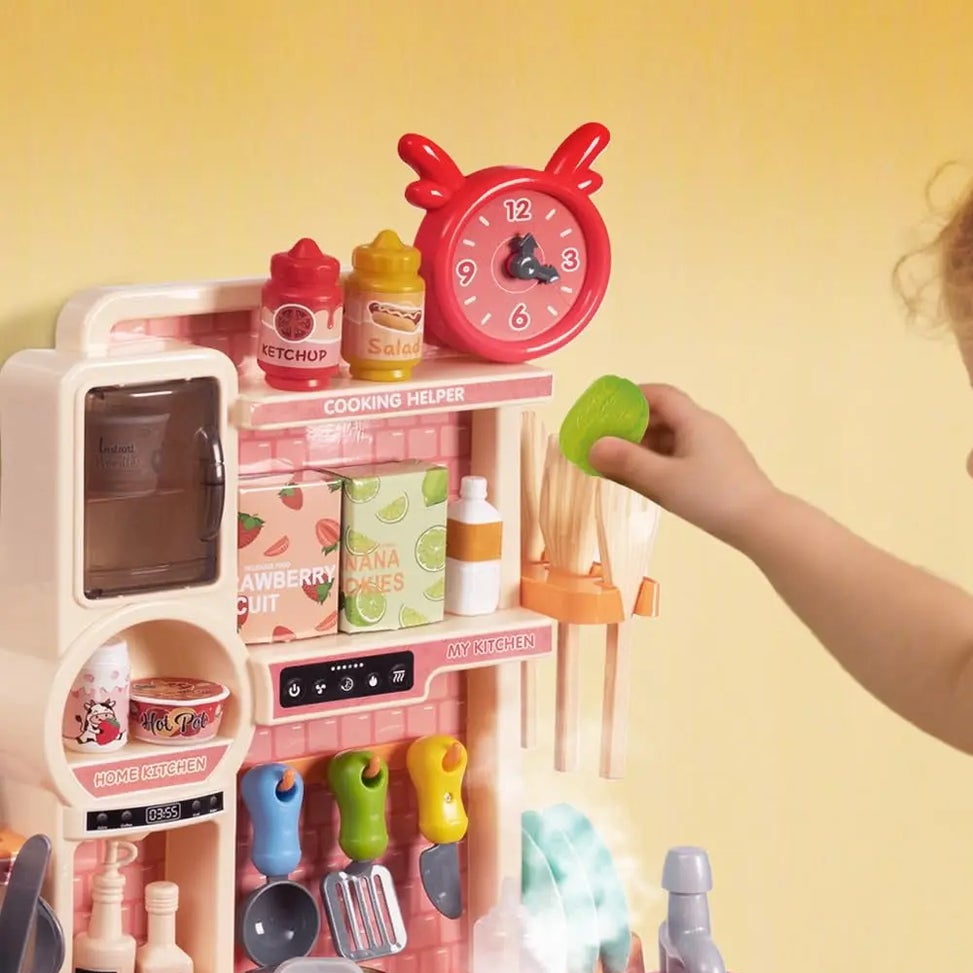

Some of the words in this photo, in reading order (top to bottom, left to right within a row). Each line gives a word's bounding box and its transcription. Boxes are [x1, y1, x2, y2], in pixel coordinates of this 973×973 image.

[504, 199, 531, 221] 12
[562, 249, 580, 271] 3
[457, 260, 476, 286] 9
[510, 304, 530, 330] 6
[261, 343, 327, 362] KETCHUP
[367, 338, 421, 356] Salad
[324, 394, 401, 414] COOKING
[407, 387, 465, 407] HELPER
[345, 548, 400, 571] NANA
[237, 564, 336, 592] AWBERRY
[344, 572, 404, 595] OKIES
[237, 594, 280, 615] CUIT
[447, 643, 470, 658] MY
[474, 634, 535, 655] KITCHEN
[140, 713, 172, 737] Hot
[175, 711, 208, 733] Pot
[94, 771, 138, 787] HOME
[142, 756, 206, 780] KITCHEN
[149, 806, 178, 821] 03:55
